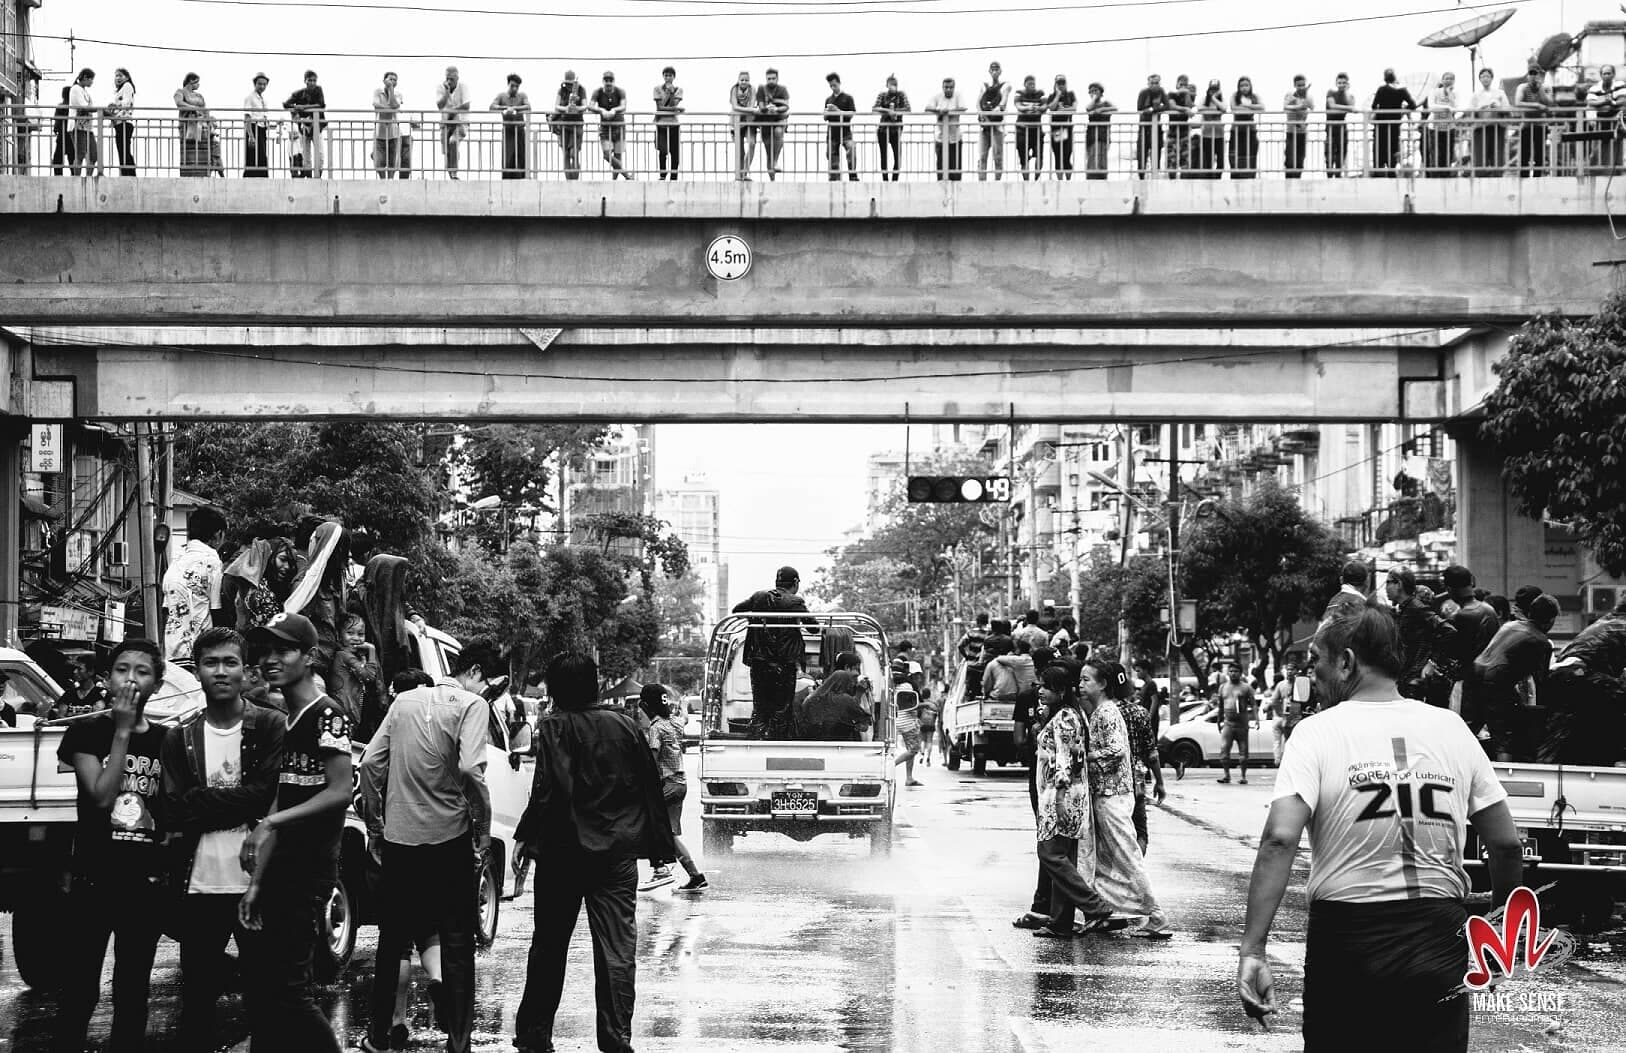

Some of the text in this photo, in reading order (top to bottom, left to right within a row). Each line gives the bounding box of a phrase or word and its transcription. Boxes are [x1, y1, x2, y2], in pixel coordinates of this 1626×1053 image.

[710, 249, 746, 265] 4.5m
[985, 478, 1010, 501] 49
[103, 754, 161, 777] ORA
[120, 774, 160, 798] MON
[1349, 769, 1391, 786] KOREA
[1393, 772, 1412, 781] TOP
[774, 798, 815, 810] 3H-6525
[1354, 782, 1455, 823] ZIC
